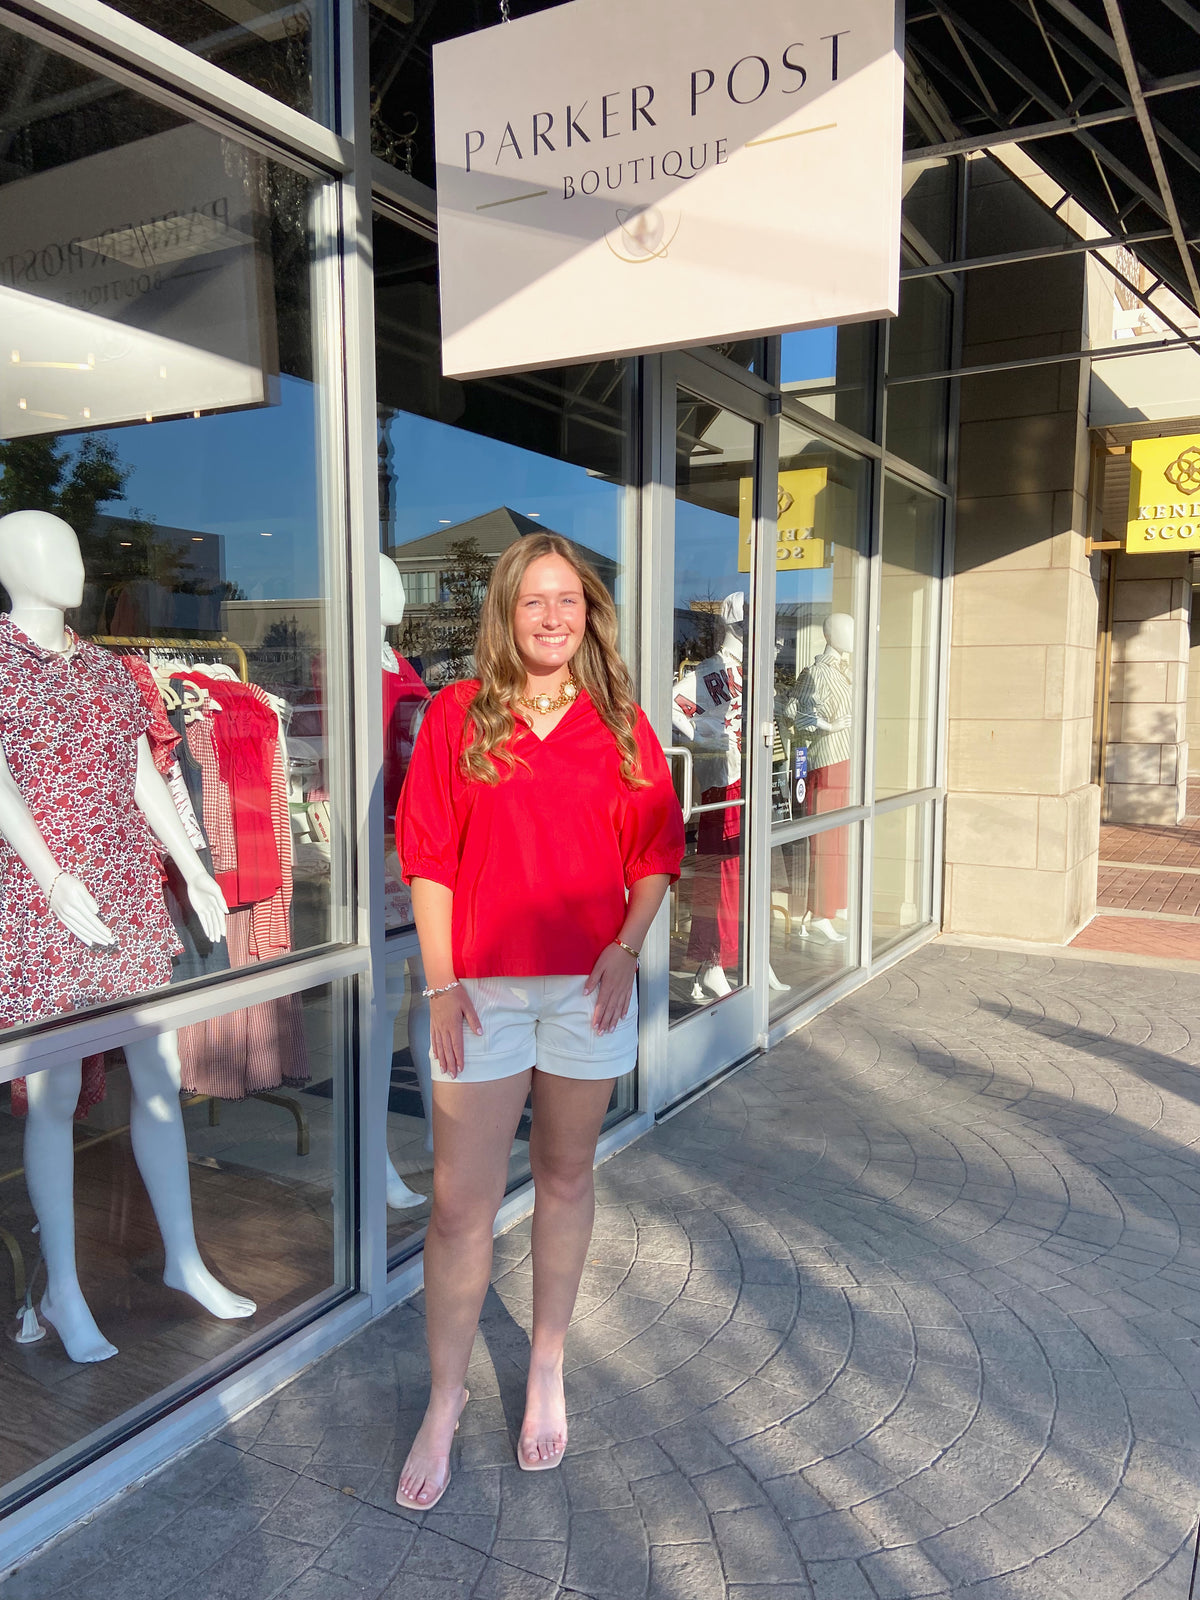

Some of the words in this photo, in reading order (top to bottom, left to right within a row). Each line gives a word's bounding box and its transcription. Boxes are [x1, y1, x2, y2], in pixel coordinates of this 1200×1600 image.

[465, 84, 657, 172] PARKER
[691, 30, 851, 116] POST
[563, 138, 729, 200] BOUTIQUE
